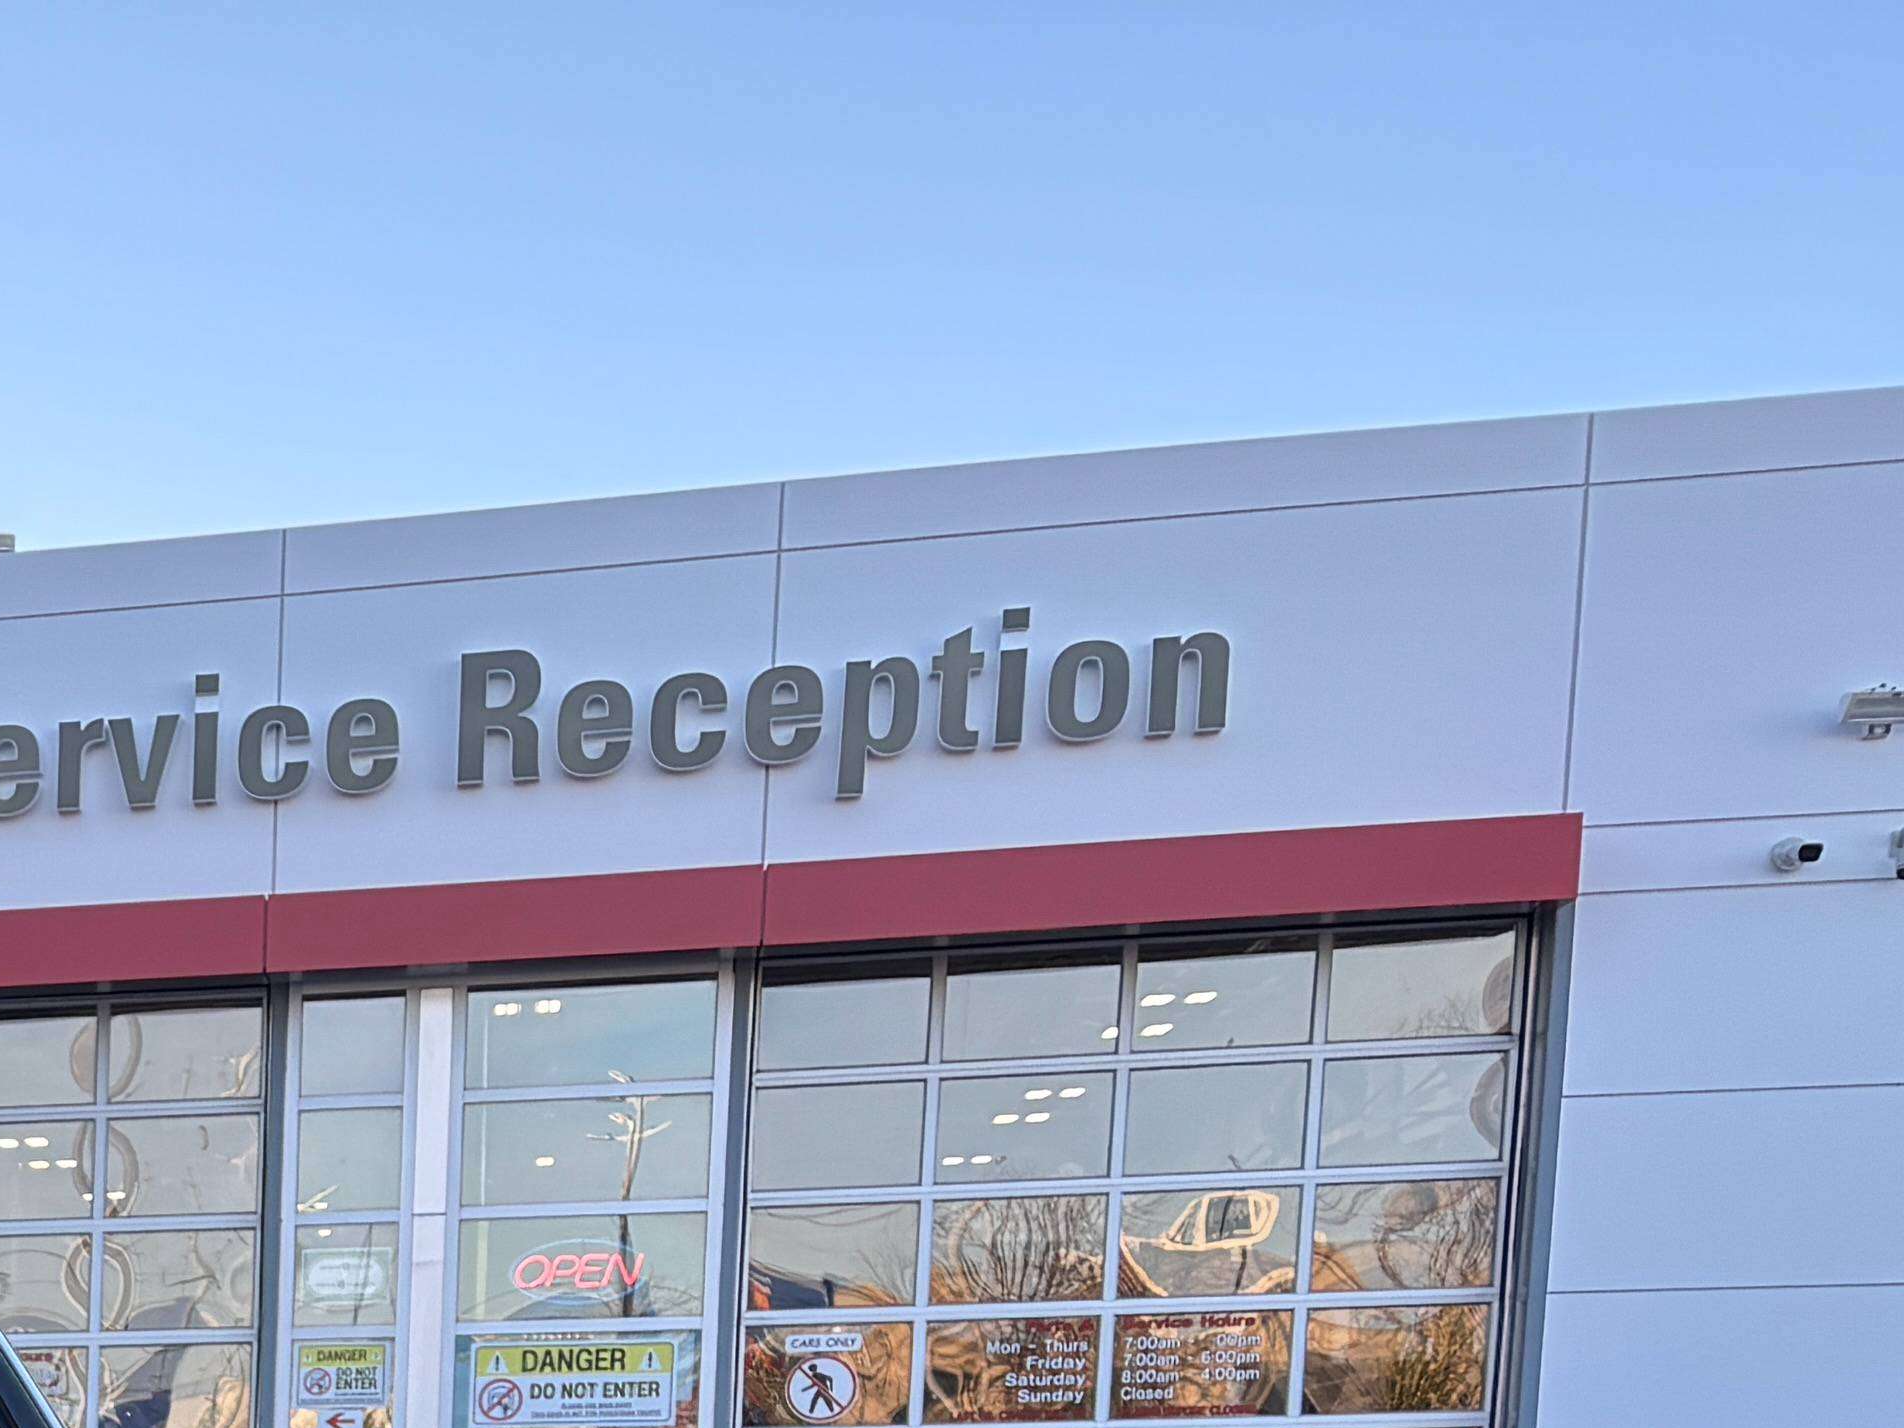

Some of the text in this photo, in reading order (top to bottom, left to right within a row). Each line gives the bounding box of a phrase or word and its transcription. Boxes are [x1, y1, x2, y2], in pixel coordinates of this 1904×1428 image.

[456, 606, 1232, 801] Reception
[513, 1252, 644, 1289] OPEN
[986, 1340, 1021, 1355] Mon
[1044, 1339, 1089, 1353] Thurs
[1124, 1336, 1181, 1350] 7:00am
[316, 1349, 367, 1362] DANGER
[521, 1349, 626, 1373] DANGER
[1025, 1355, 1086, 1371] Friday
[1124, 1353, 1180, 1367] 7:00am
[1201, 1351, 1260, 1365] 6:00pm
[336, 1366, 378, 1377] DO NOT
[1004, 1372, 1086, 1388] Saturday
[1122, 1370, 1179, 1384] 8:00am
[336, 1378, 377, 1390] ENTER
[529, 1381, 660, 1400] DO NOT ENTER
[1017, 1387, 1175, 1404] Sunday Closed
